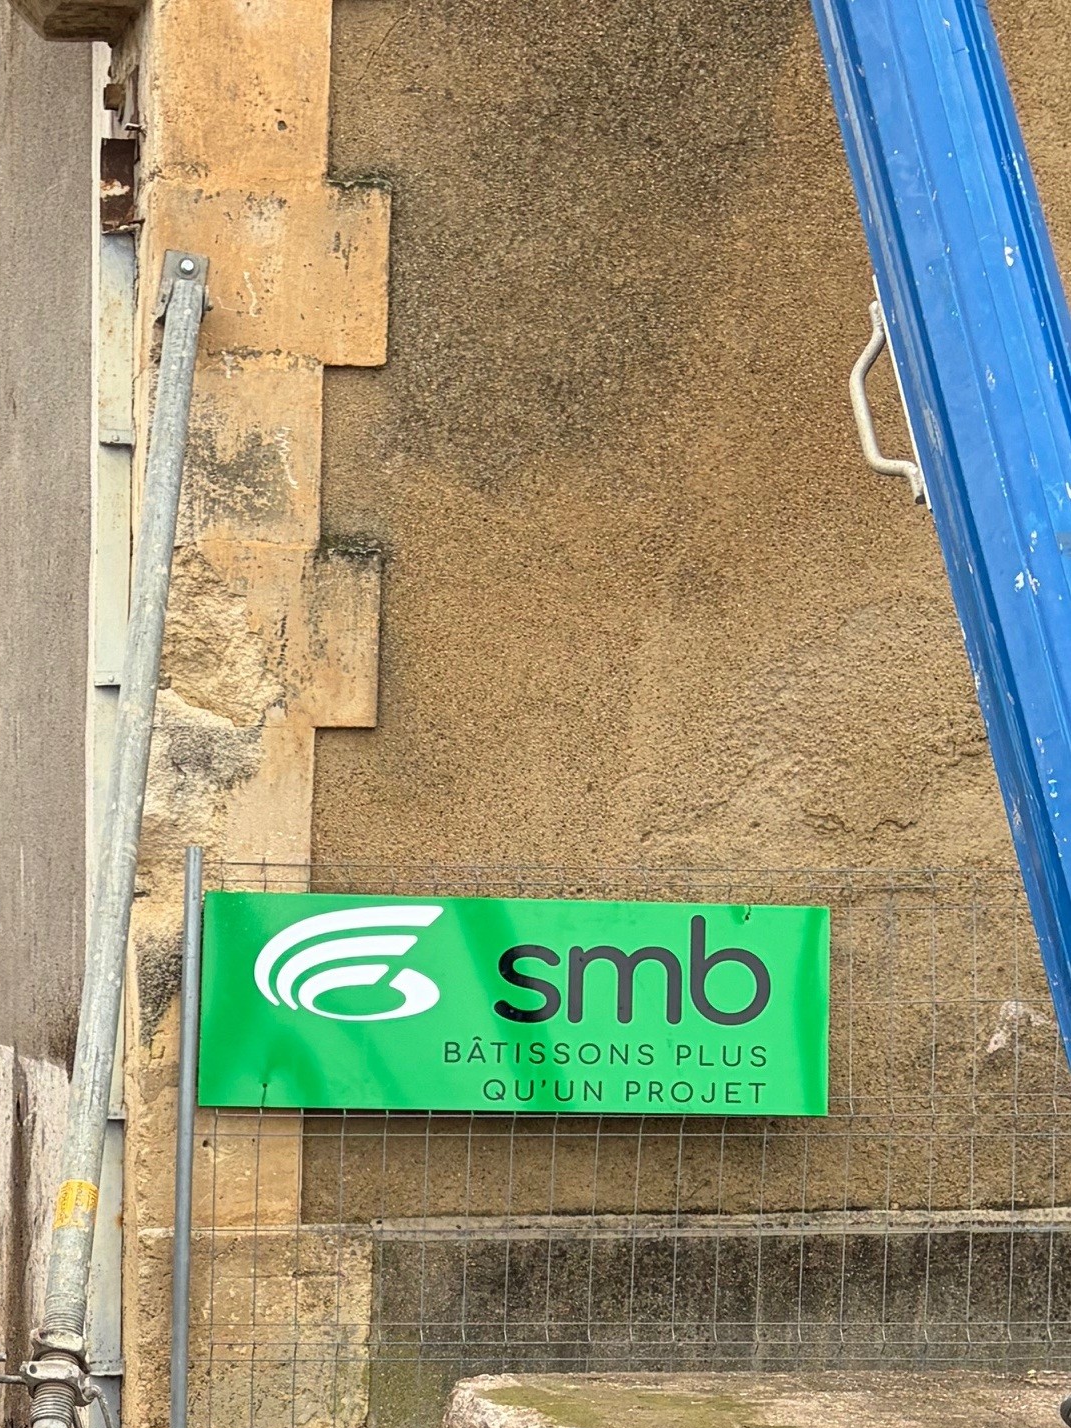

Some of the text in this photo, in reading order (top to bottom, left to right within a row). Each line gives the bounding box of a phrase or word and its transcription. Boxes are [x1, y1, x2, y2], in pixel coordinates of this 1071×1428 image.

[493, 914, 771, 1026] smb
[443, 1036, 768, 1068] BÂTISSONS PLUS
[482, 1079, 767, 1104] QU'UN PROJET
